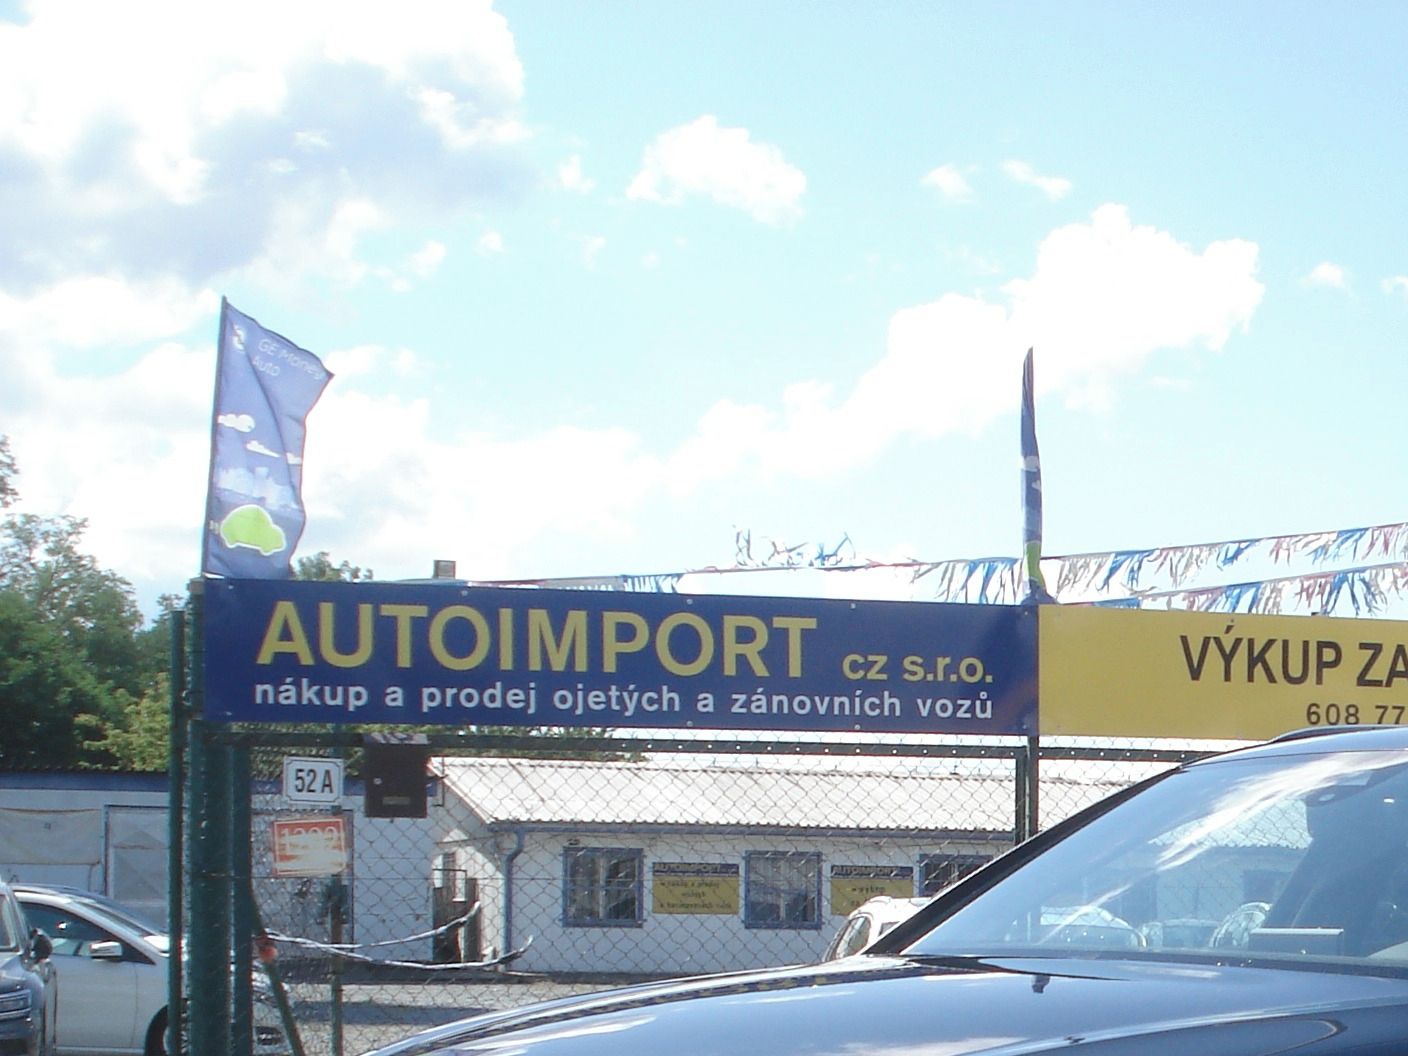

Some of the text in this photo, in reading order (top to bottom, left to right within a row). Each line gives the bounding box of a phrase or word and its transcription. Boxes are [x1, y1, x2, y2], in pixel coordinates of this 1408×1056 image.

[258, 338, 281, 356] GE
[255, 600, 994, 684] AUTOIMPORT cz s.r.o.
[1180, 624, 1343, 686] VÝKUP
[255, 677, 993, 719] nákup a prodej ojetých a zánovních vozů
[1306, 702, 1360, 725] 608
[1374, 704, 1405, 725] 77
[294, 767, 334, 794] 52 A
